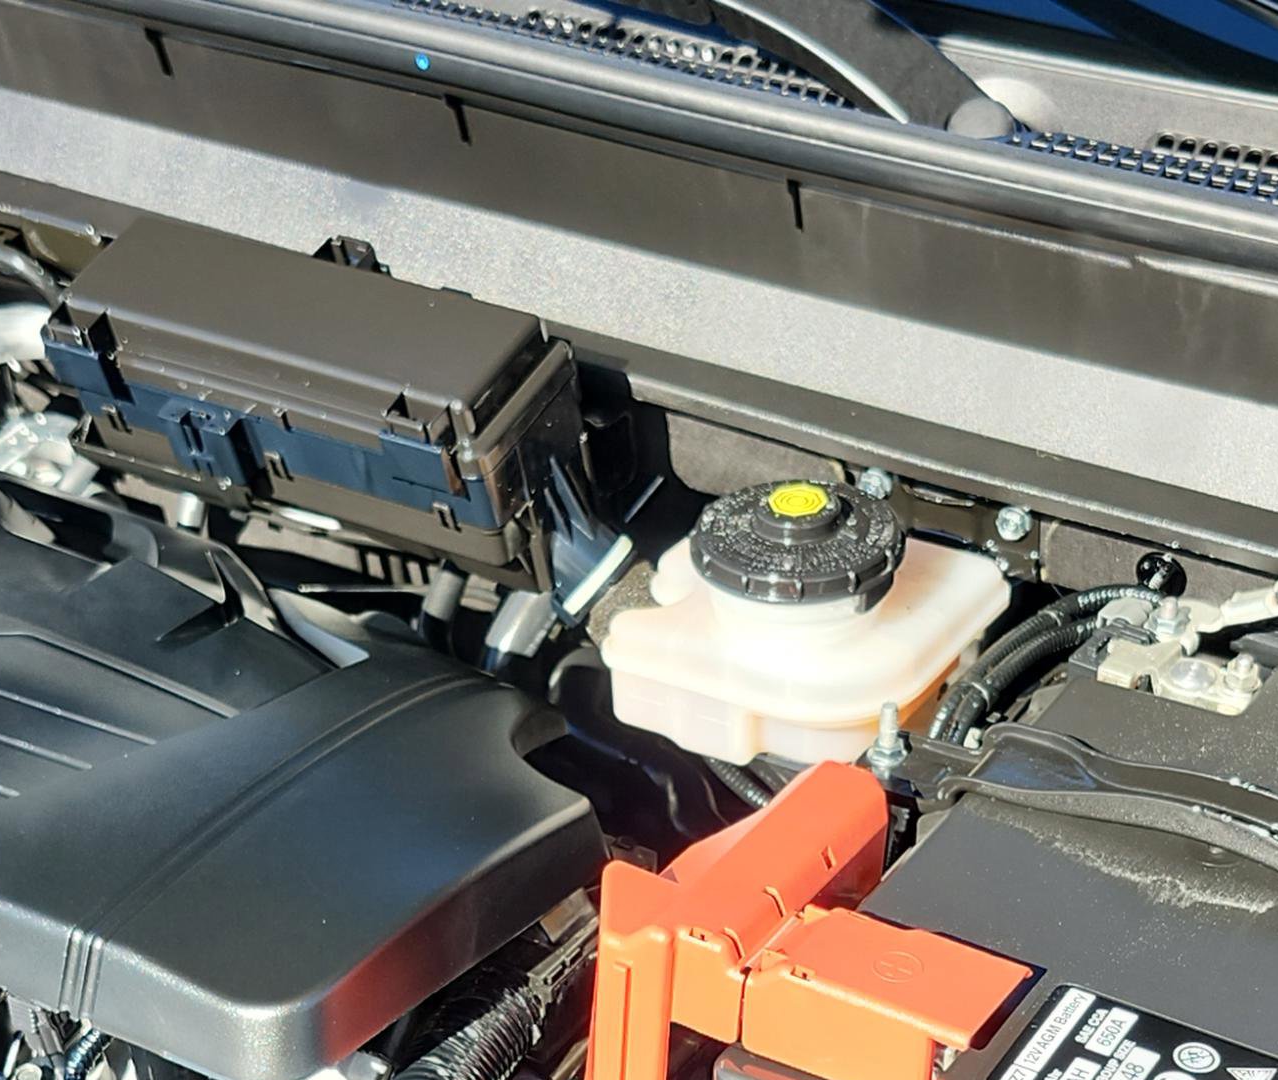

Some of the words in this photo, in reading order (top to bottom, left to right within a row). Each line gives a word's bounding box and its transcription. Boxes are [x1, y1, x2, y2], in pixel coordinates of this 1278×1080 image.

[1024, 1046, 1042, 1065] 12V
[1040, 1024, 1062, 1050] AGM
[1054, 992, 1087, 1025] Battery
[1074, 1025, 1095, 1044] SAE
[1088, 1008, 1109, 1027] CCA
[1097, 1018, 1126, 1047] 650A
[1121, 1062, 1145, 1080] 48
